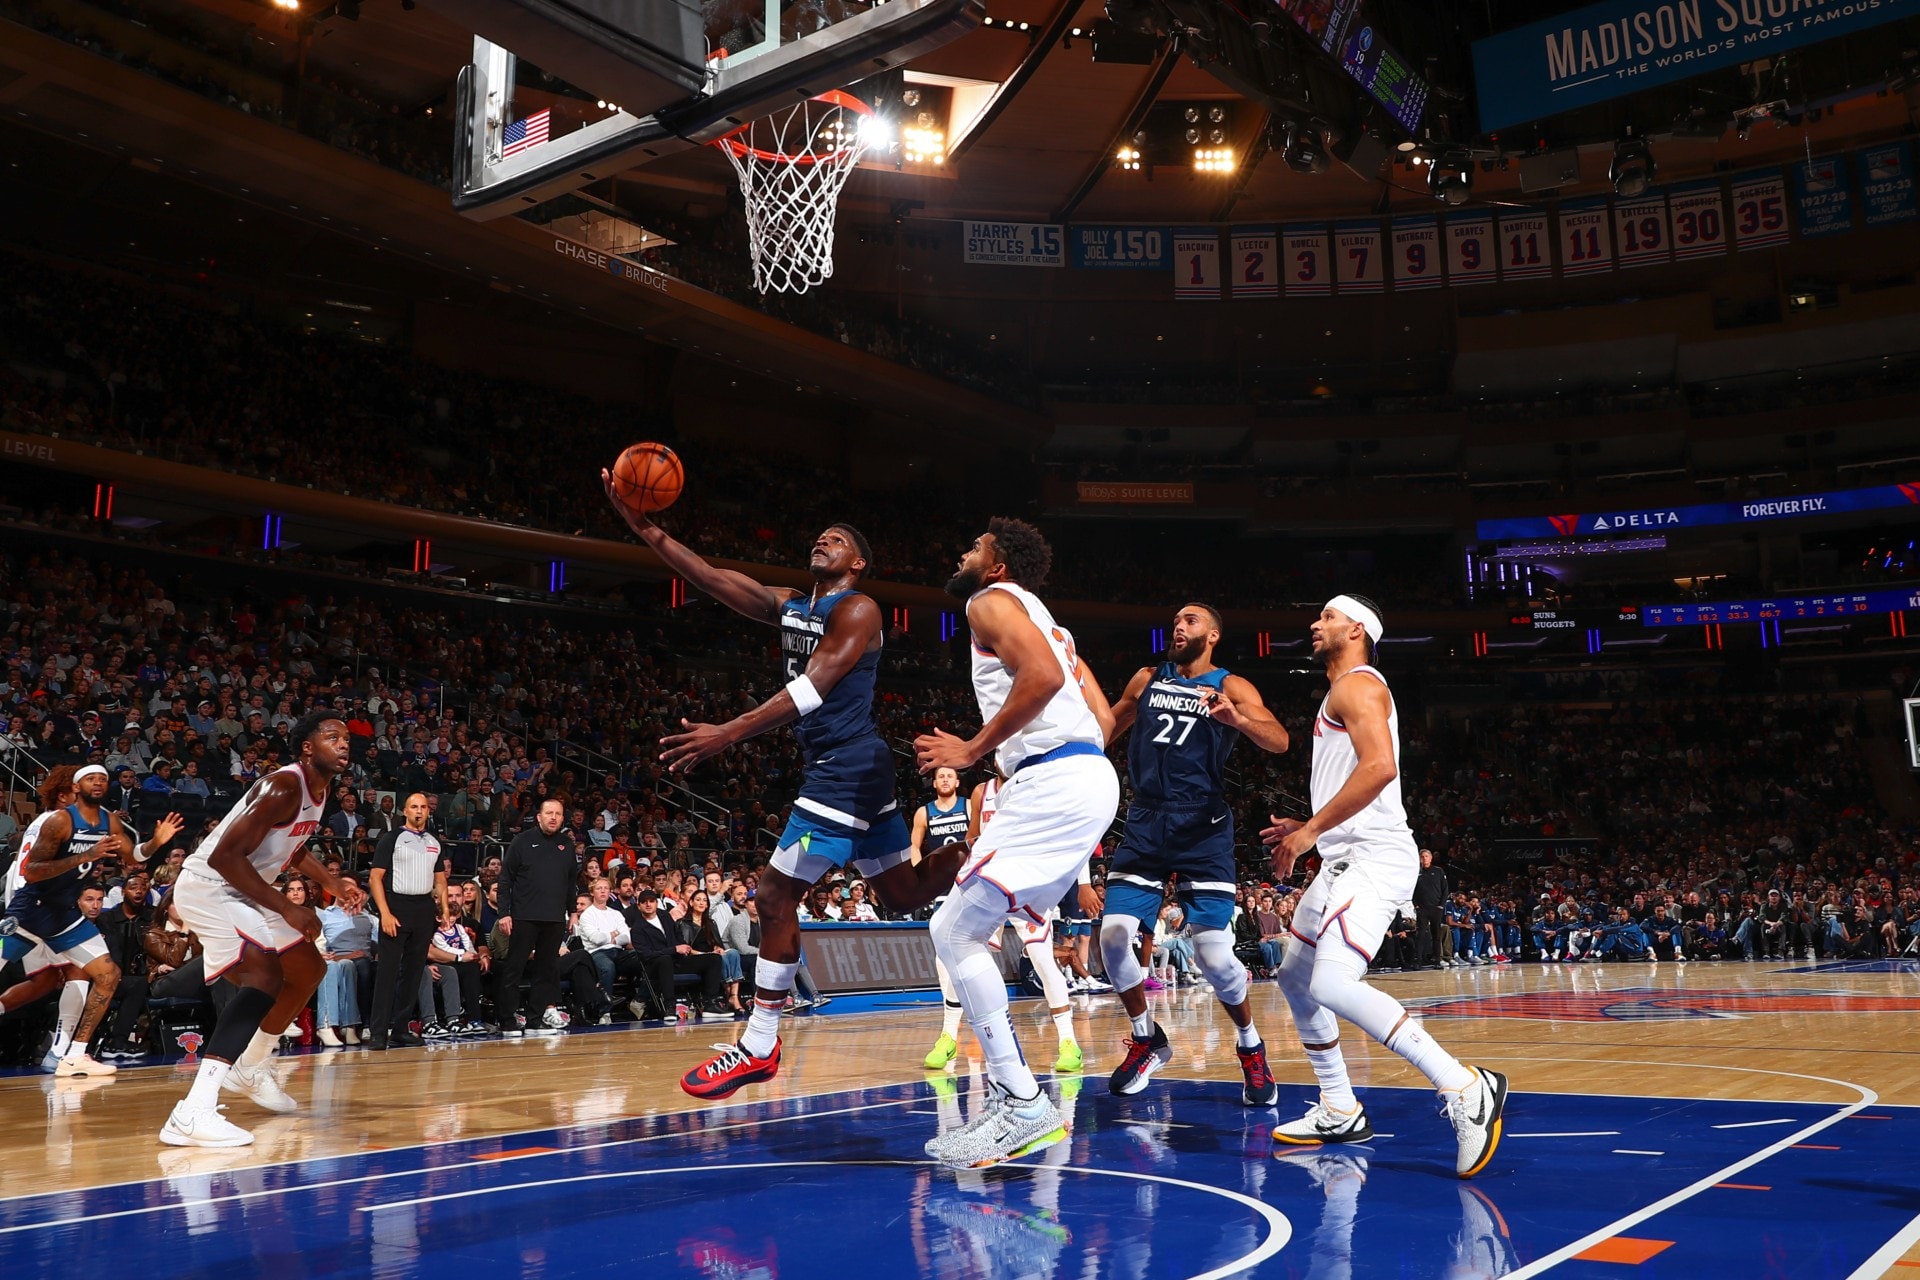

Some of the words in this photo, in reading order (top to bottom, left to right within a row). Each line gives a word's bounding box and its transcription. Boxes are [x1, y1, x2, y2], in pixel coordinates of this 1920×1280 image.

[1545, 0, 1702, 82] MADISON
[1616, 65, 1649, 79] THE
[1655, 39, 1736, 69] WORLD'S
[1743, 21, 1794, 44] MOST
[1803, 0, 1881, 28] FAMOUS
[1355, 50, 1365, 64] 19
[1864, 178, 1912, 197] 1932-33
[1800, 191, 1847, 208] 1927-28
[1870, 192, 1908, 206] STANLEY
[1881, 203, 1899, 213] CUP
[1566, 215, 1601, 227] MESSIER
[1737, 196, 1783, 234] 35
[1806, 204, 1842, 218] STANLEY
[1816, 214, 1834, 224] CUP
[1866, 208, 1917, 224] CHAMPIONS
[972, 223, 1019, 240] HARRY
[1623, 217, 1661, 252] 19
[1676, 208, 1721, 244] 30
[1801, 220, 1851, 236] CHAMPIONS
[968, 238, 1024, 255] STYLES
[1030, 226, 1060, 256] 15
[1082, 230, 1109, 244] BILLY
[1113, 230, 1162, 260] 150
[1237, 240, 1269, 250] LEETCH
[1341, 236, 1375, 247] GILBERT
[1569, 227, 1602, 261] 11
[1084, 245, 1109, 260] JOEL
[1406, 243, 1426, 274] 9
[1461, 238, 1481, 270] 9
[1510, 232, 1541, 266] 11
[554, 239, 607, 269] CHASE
[625, 265, 668, 292] BRIDGE
[1190, 254, 1204, 285] 1
[1244, 251, 1264, 283] 2
[1296, 251, 1316, 281] 3
[1349, 248, 1368, 279] 7
[4, 439, 57, 462] LEVEL
[1121, 488, 1153, 498] SUITE
[1156, 488, 1190, 498] LEVEL
[1742, 499, 1800, 518] FOREVER
[1801, 497, 1827, 512] FLY.
[1614, 511, 1680, 528] DELTA
[1533, 611, 1556, 619] SUNS
[1654, 616, 1661, 624] 3
[1675, 615, 1683, 623] 6
[1697, 614, 1718, 622] 18.2
[1759, 609, 1781, 618] 66.7
[1797, 608, 1805, 616] 2
[1816, 606, 1824, 614] 2
[1854, 603, 1867, 611] 10
[1534, 620, 1576, 629] NUGGETS
[787, 657, 799, 680] 5
[1152, 713, 1198, 746] 27
[929, 822, 969, 836] MINNESOTA
[77, 861, 93, 880] 9
[816, 937, 867, 984] THE
[861, 935, 937, 981] BETTER
